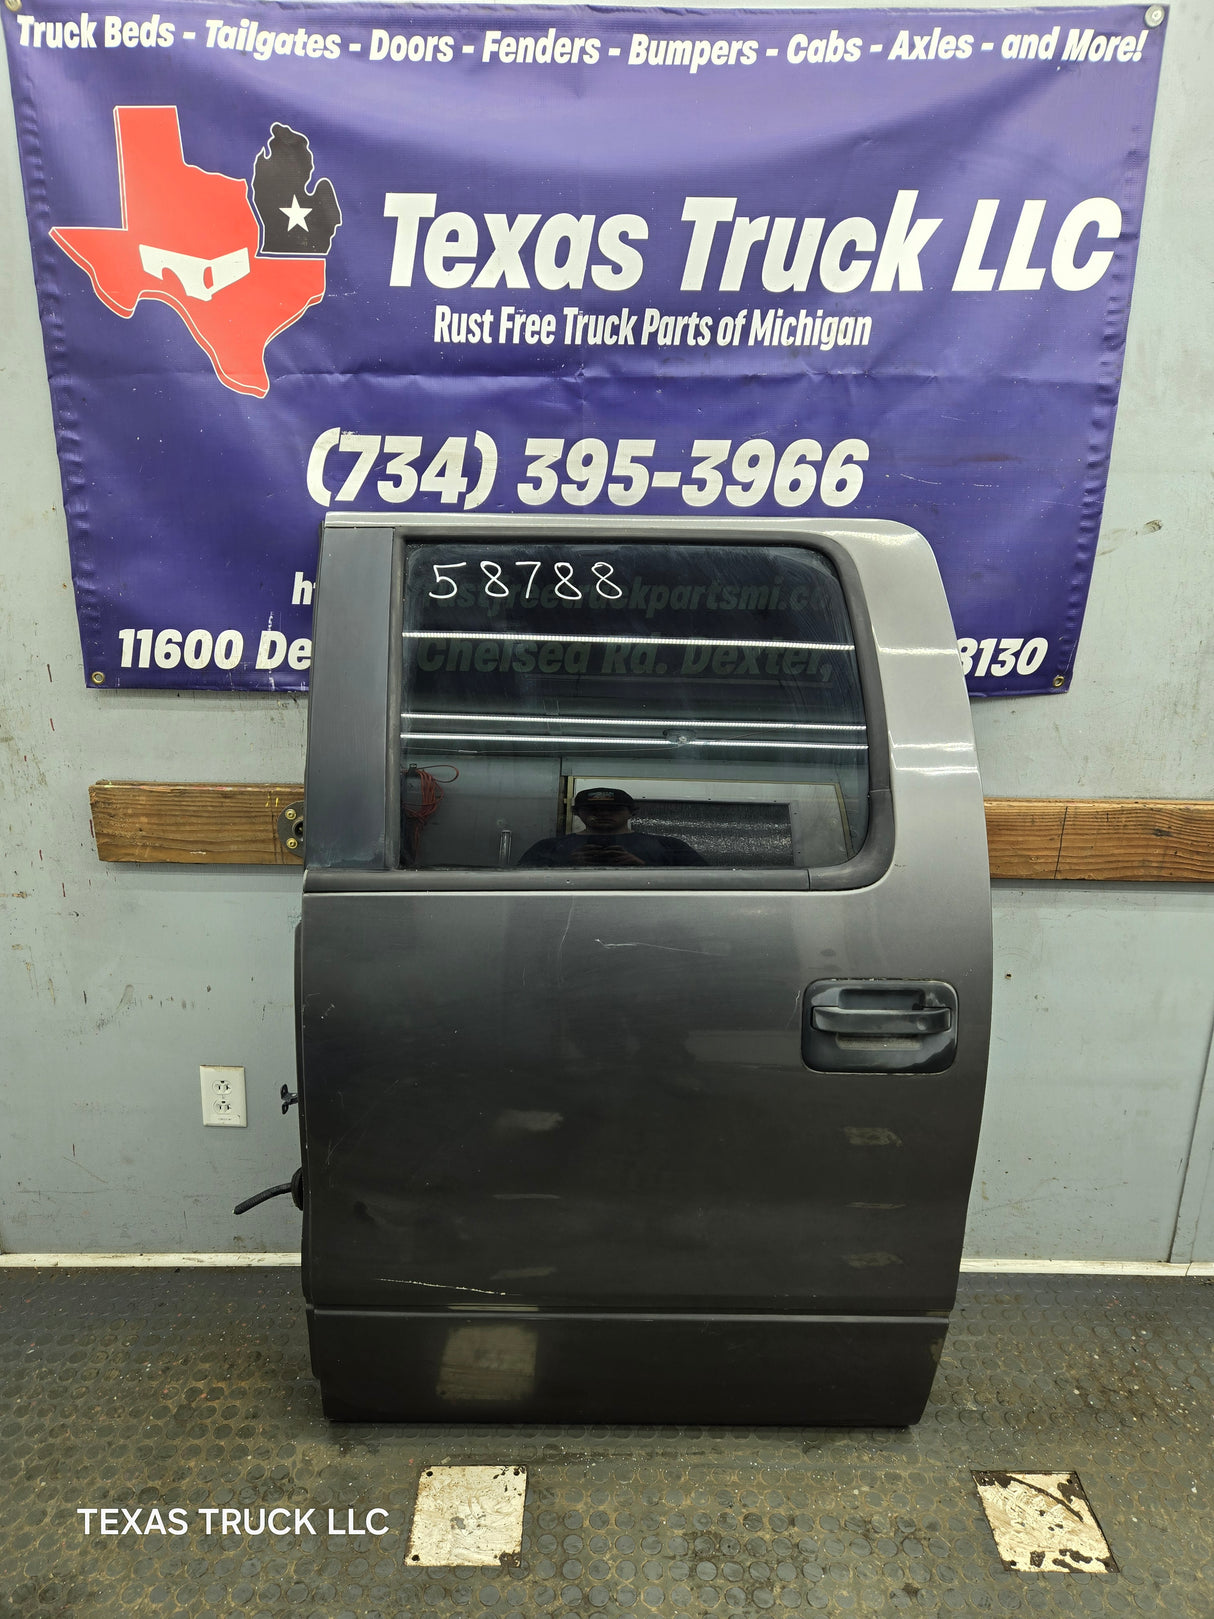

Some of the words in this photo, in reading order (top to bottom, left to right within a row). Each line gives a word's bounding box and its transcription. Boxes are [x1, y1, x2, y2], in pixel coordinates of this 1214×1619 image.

[16, 12, 98, 49] Truck
[104, 13, 177, 48] Beds
[181, 30, 197, 42] -
[204, 17, 342, 62] Tailgates
[348, 42, 362, 52] -
[368, 28, 455, 63] Doors
[461, 44, 475, 54] -
[481, 27, 602, 65] Fenders
[607, 47, 622, 57] -
[627, 33, 760, 75] Bumpers
[765, 48, 779, 57] -
[786, 29, 864, 65] Cabs
[868, 43, 884, 54] -
[886, 26, 975, 62] Axles
[980, 41, 995, 52] -
[1000, 25, 1062, 61] and
[1061, 28, 1150, 63] More!
[383, 192, 649, 292] Texas
[679, 189, 944, 294] Truck
[951, 196, 1123, 292] LLC
[433, 304, 494, 344] Rust
[498, 306, 557, 345] Free
[563, 306, 637, 346] Truck
[640, 308, 713, 347] Parts
[716, 308, 748, 347] of
[747, 307, 873, 352] Michigan
[306, 426, 498, 510] (734)
[517, 437, 870, 507] 395-3966
[428, 560, 623, 600] 58788
[118, 628, 244, 670] 11600
[417, 632, 591, 673] Chelsea
[601, 632, 667, 673] Rd.
[955, 637, 1049, 677] 8130
